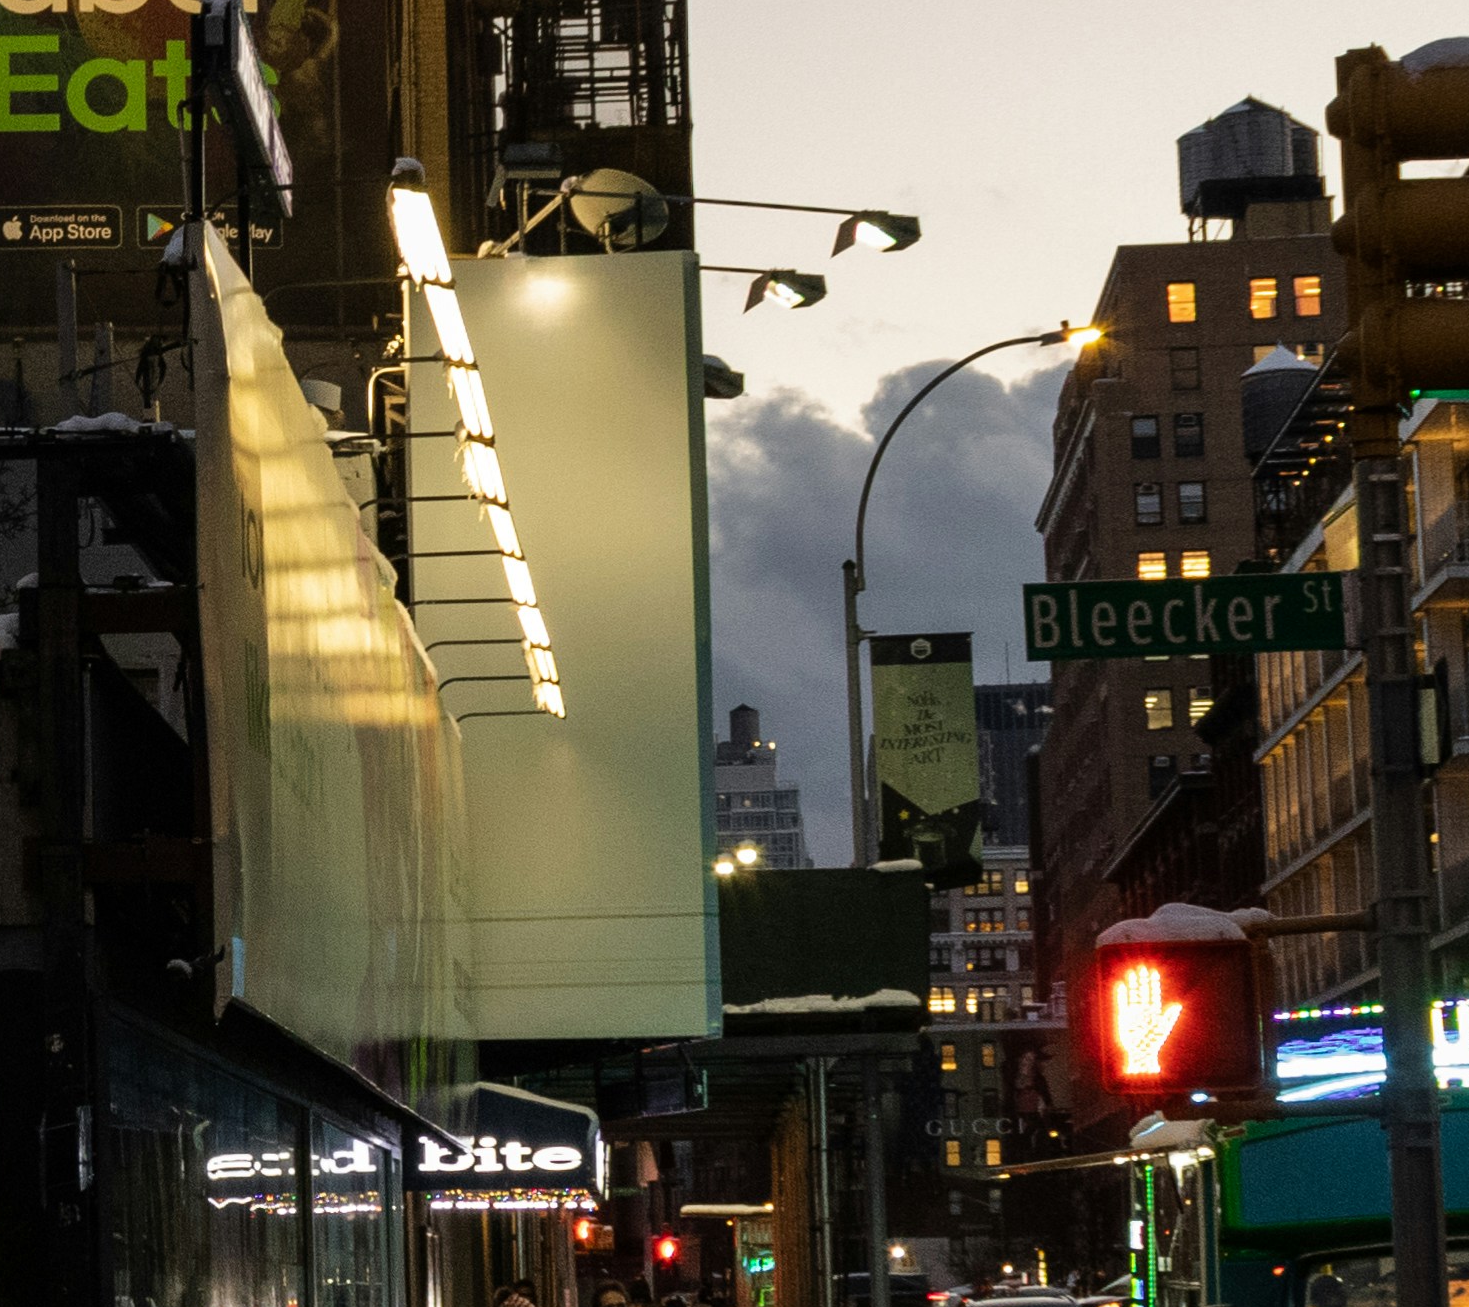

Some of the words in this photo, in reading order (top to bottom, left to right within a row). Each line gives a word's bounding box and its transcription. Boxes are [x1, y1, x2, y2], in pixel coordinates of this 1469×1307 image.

[29, 223, 64, 242] App
[66, 224, 112, 240] Store
[250, 222, 274, 243] lay
[1031, 583, 1282, 650] Bleecker
[1302, 580, 1334, 614] St
[924, 1117, 1026, 1137] GUCCI
[418, 1137, 582, 1172] bite
